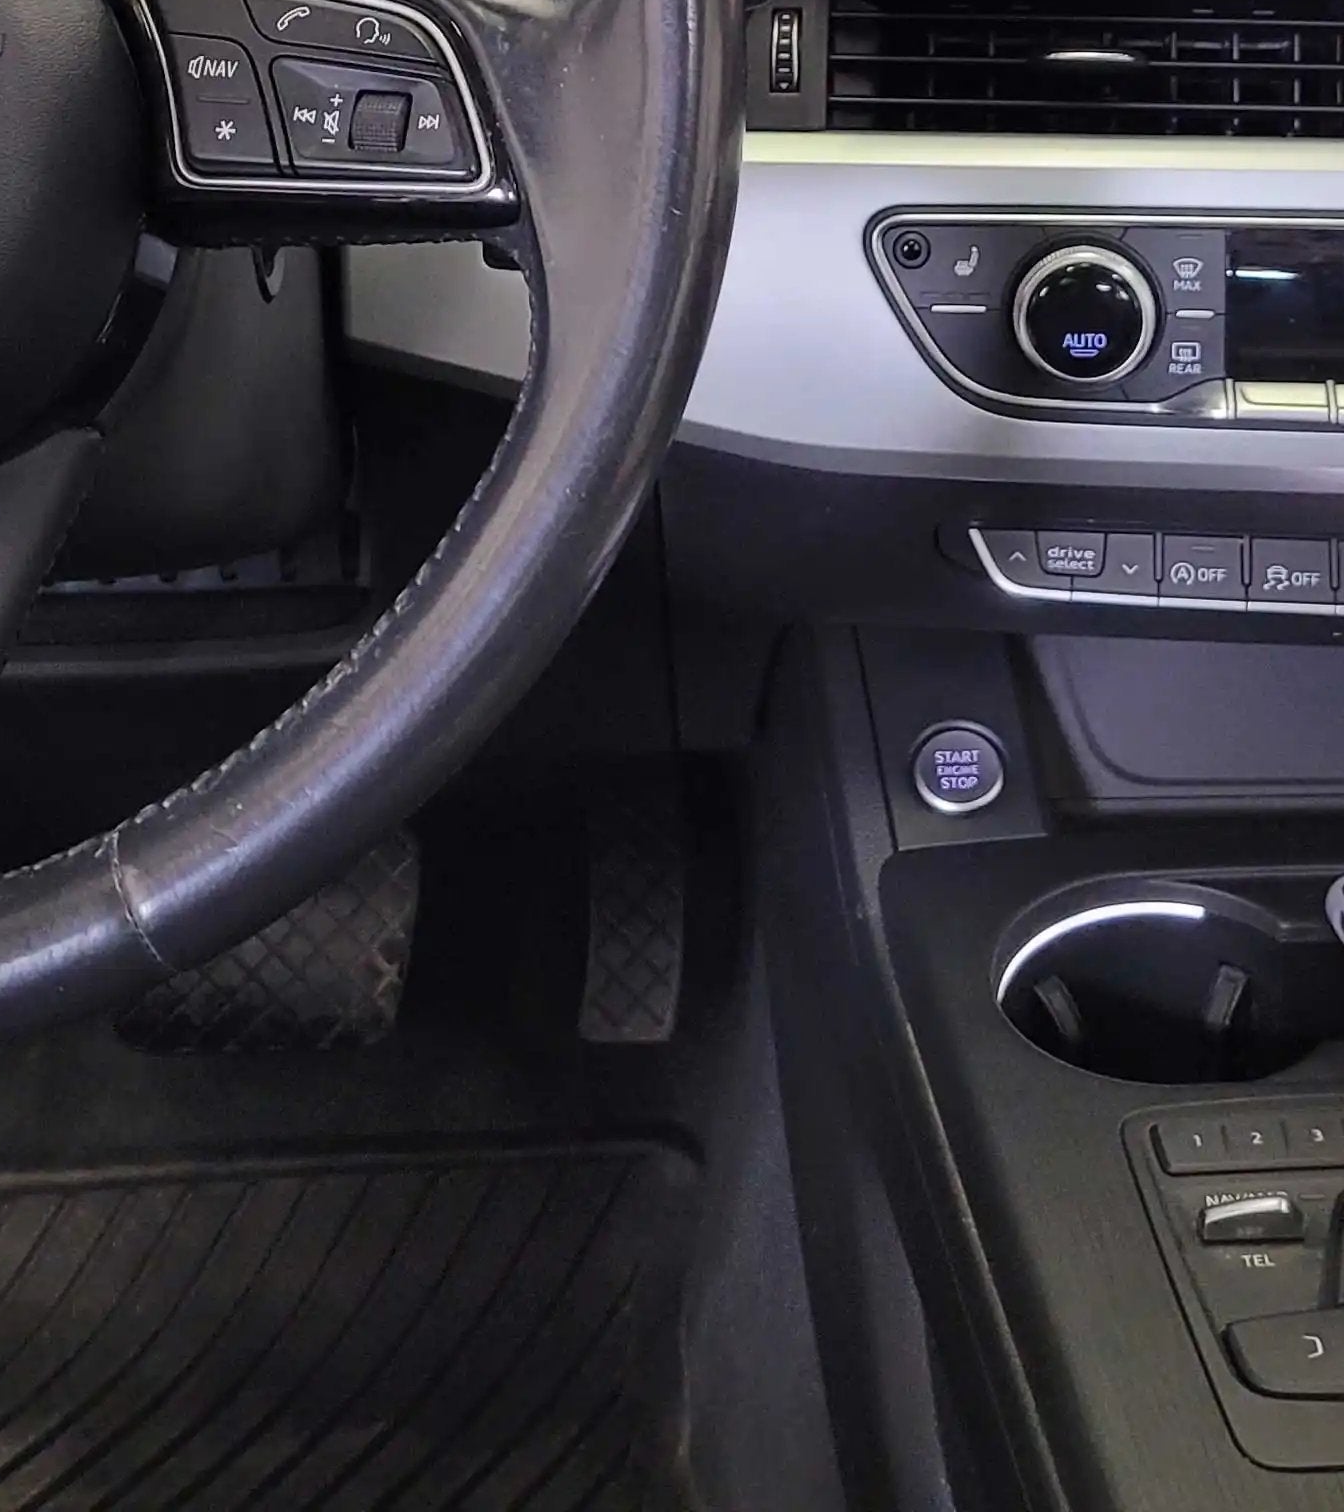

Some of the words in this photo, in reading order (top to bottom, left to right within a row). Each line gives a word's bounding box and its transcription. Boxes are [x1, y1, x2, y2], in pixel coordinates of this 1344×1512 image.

[203, 60, 238, 78] NAV
[1173, 279, 1202, 292] MAX
[1062, 332, 1108, 350] AUTO
[1168, 363, 1203, 375] REAR
[1047, 546, 1096, 560] drive
[1047, 558, 1095, 571] select
[1197, 568, 1228, 582] OFF
[1291, 572, 1321, 586] OFF
[934, 751, 979, 763] START
[940, 777, 978, 789] STOP
[1193, 1134, 1202, 1148] 1
[1252, 1131, 1264, 1145] 2
[1311, 1128, 1325, 1142] 3
[1240, 1253, 1276, 1269] TEL
